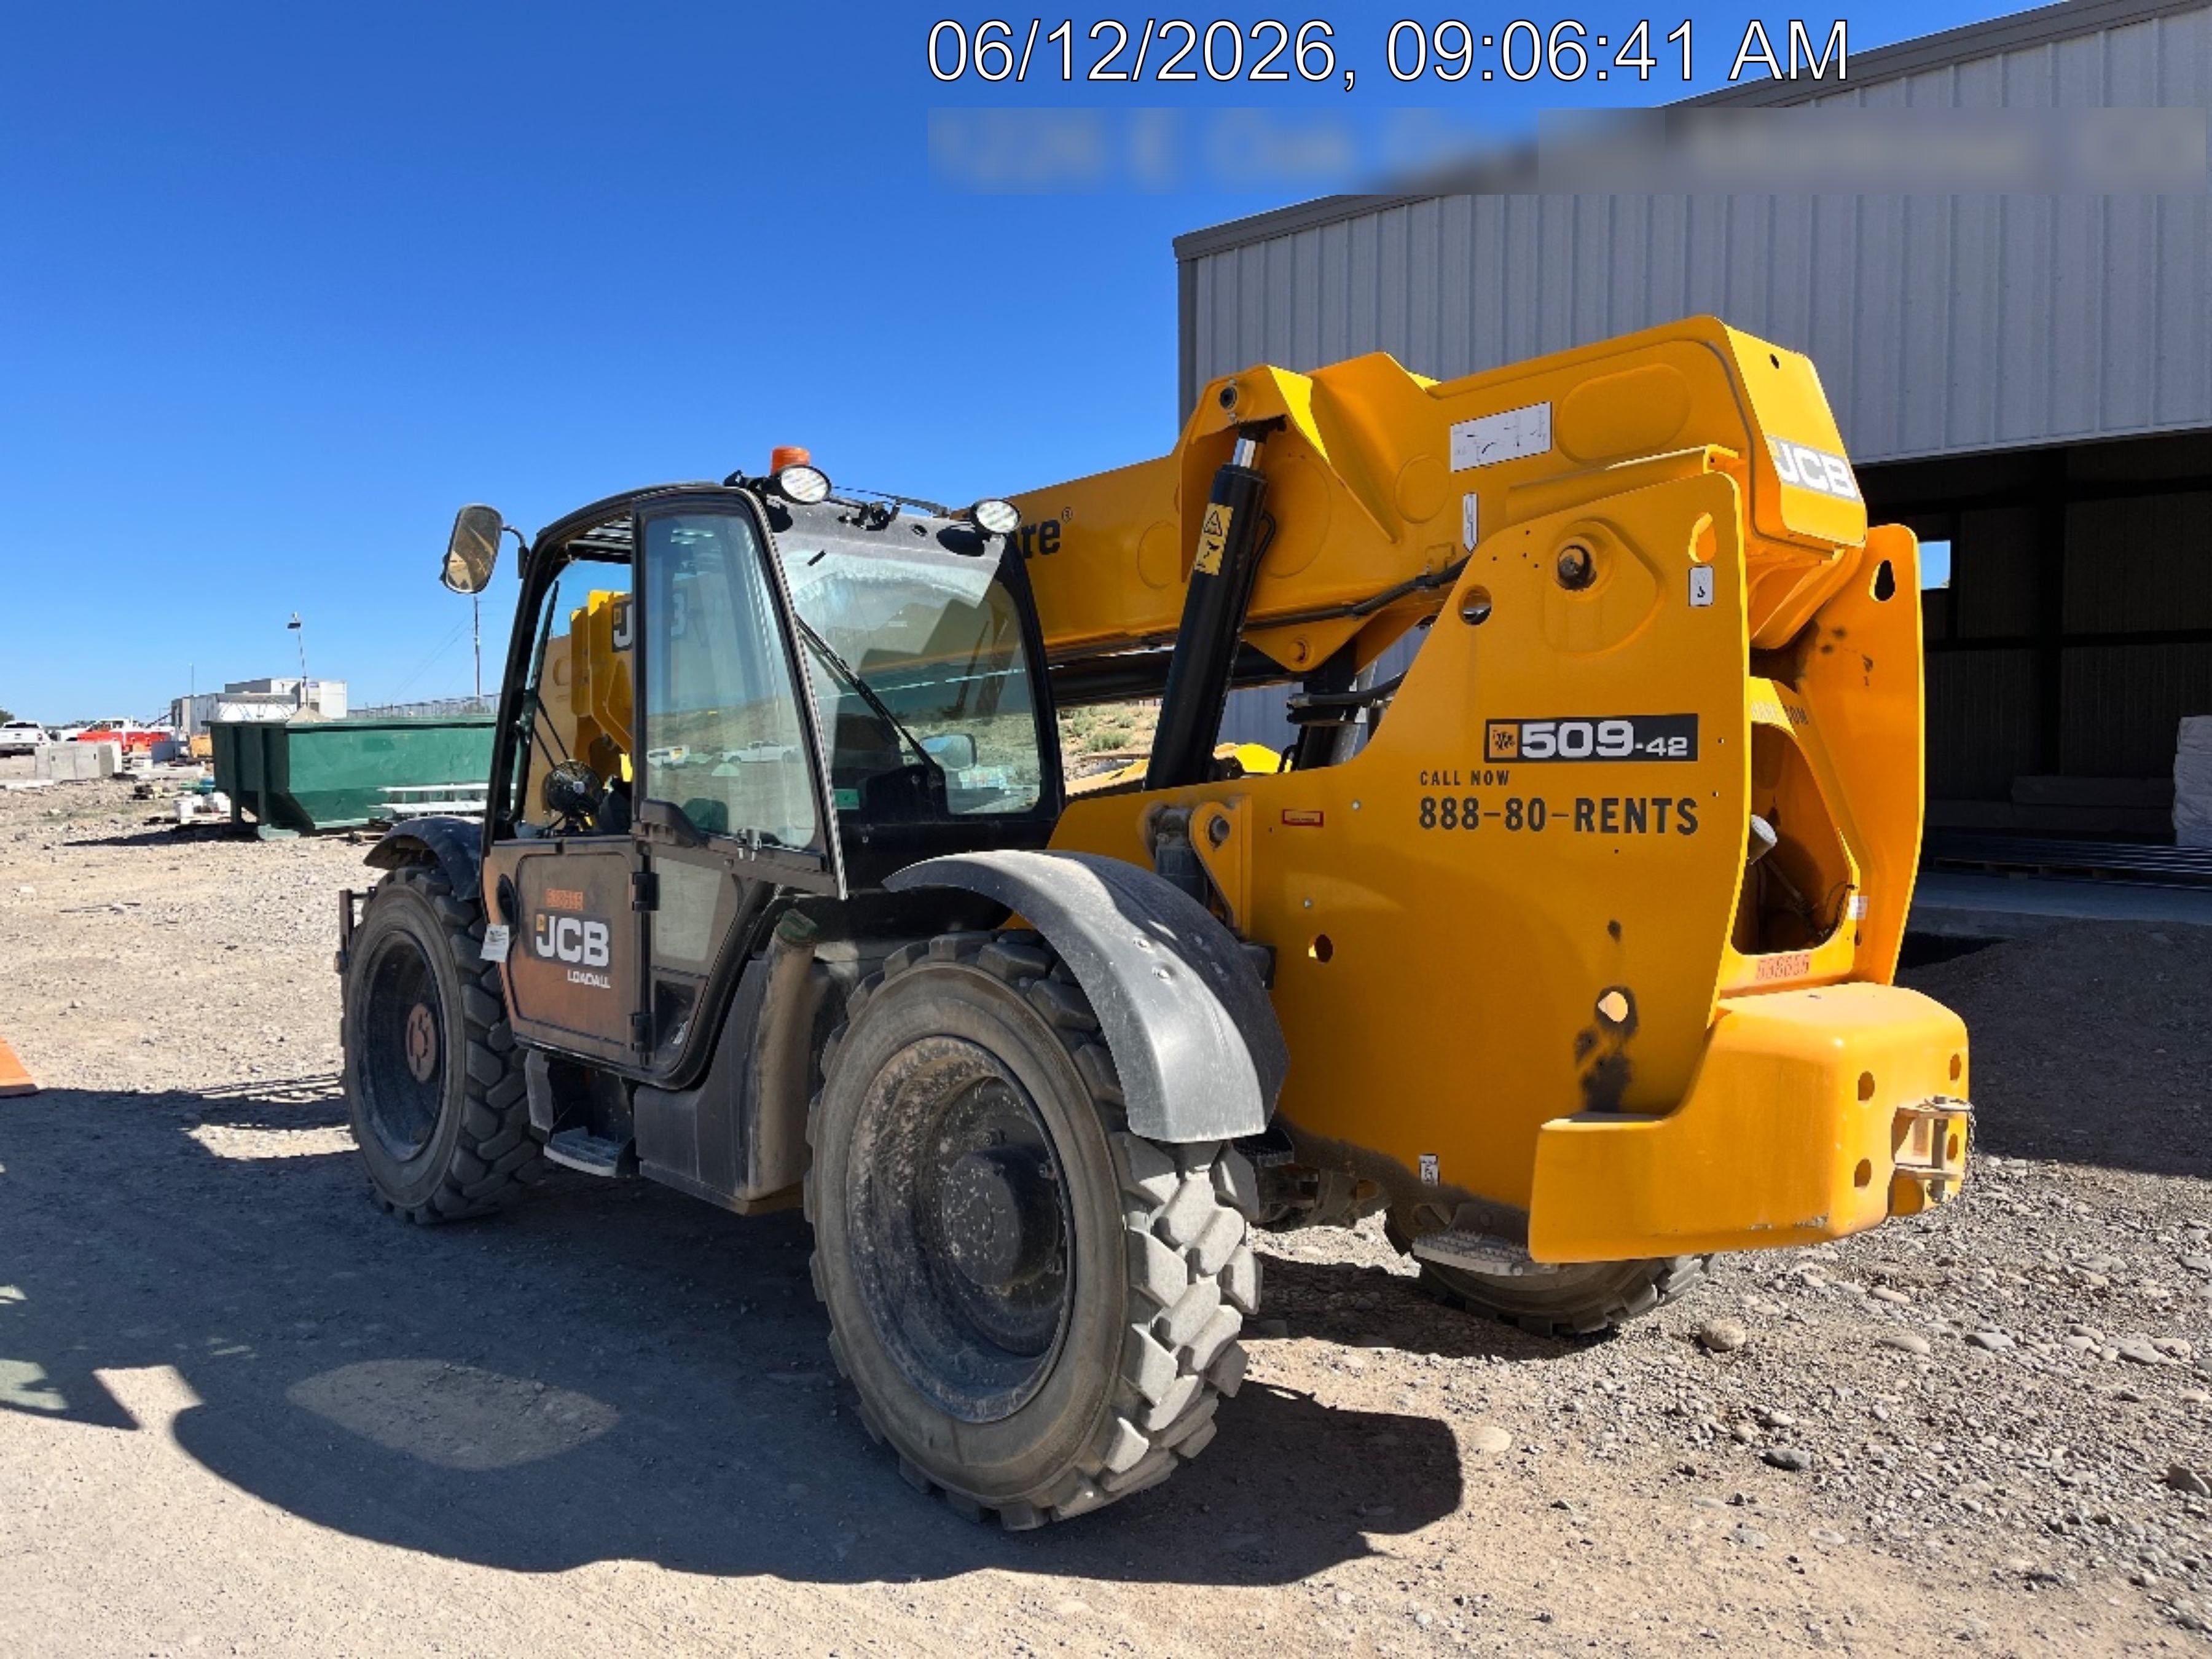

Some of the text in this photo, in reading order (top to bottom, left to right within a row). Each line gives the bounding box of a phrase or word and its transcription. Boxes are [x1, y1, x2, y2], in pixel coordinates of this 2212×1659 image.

[1773, 441, 1857, 499] JCB
[1521, 720, 1687, 758] 509-42
[1420, 770, 1510, 786] CALL NOW
[1419, 796, 1698, 836] 888-80-RENTS
[536, 916, 610, 967] JCB
[567, 970, 611, 989] LOADALL
